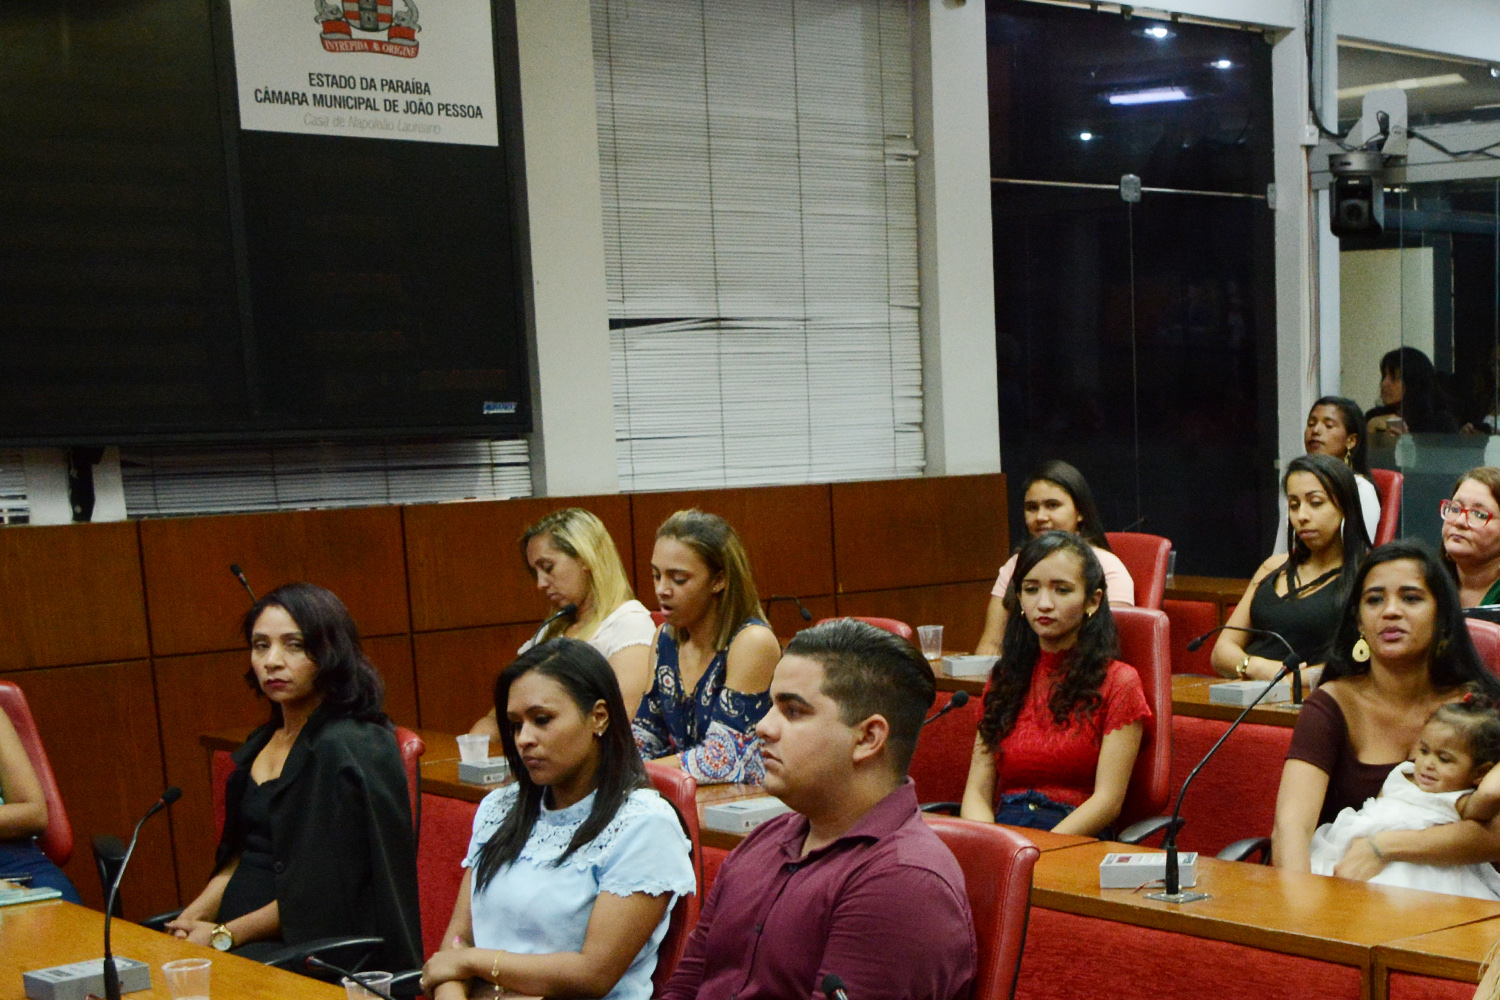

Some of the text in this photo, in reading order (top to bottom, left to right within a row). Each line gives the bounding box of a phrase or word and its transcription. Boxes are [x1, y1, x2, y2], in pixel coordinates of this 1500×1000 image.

[325, 39, 369, 51] INTREPIDA
[382, 43, 417, 57] ORIGINE
[308, 72, 431, 95] ESTADO DA PARAÍBA
[254, 86, 483, 119] CÂMARA MUNICIPAL DE JOÃO PESSOA
[304, 112, 330, 127] Casa
[333, 115, 345, 128] de
[398, 119, 441, 135] Laureano
